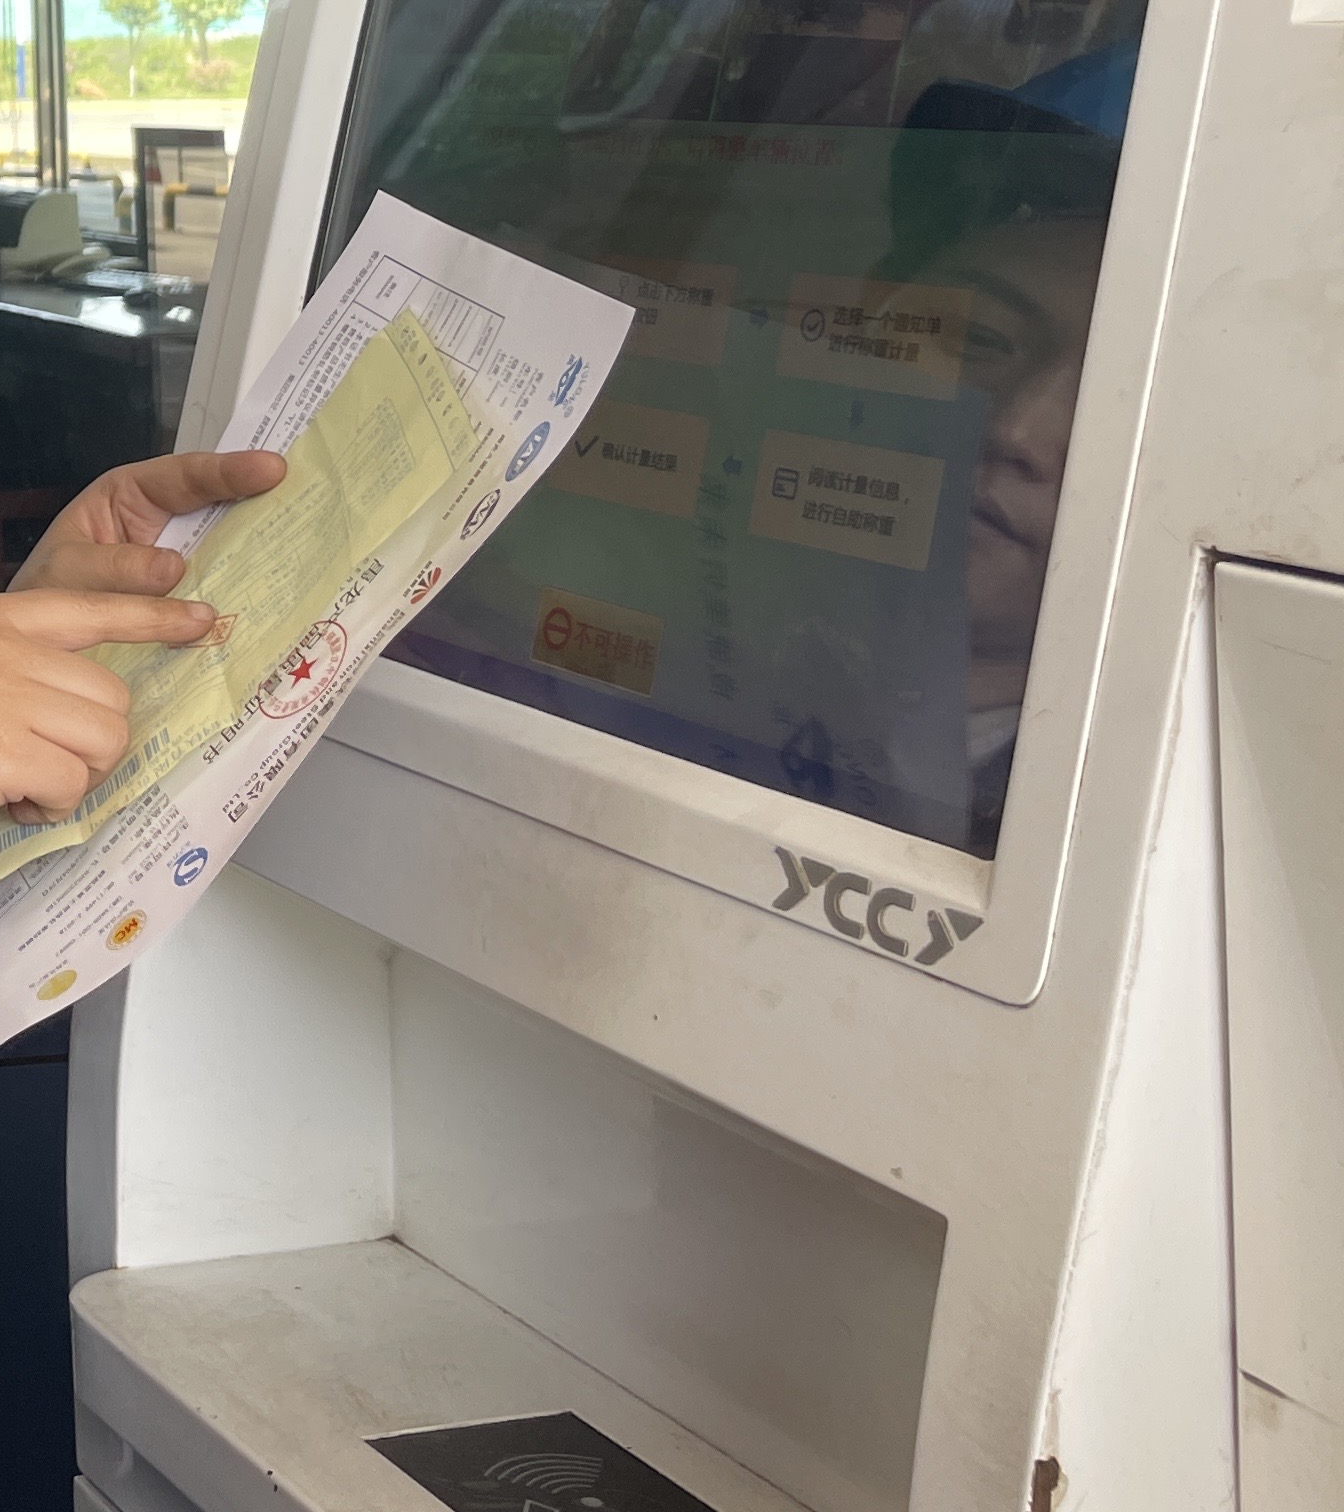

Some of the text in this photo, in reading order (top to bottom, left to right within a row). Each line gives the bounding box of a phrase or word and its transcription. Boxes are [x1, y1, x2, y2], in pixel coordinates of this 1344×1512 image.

[827, 335, 920, 363] 进行称重计量
[602, 441, 678, 472] 确认计量结果
[802, 499, 896, 536] 进行自助称重
[575, 621, 655, 670] 不可操作
